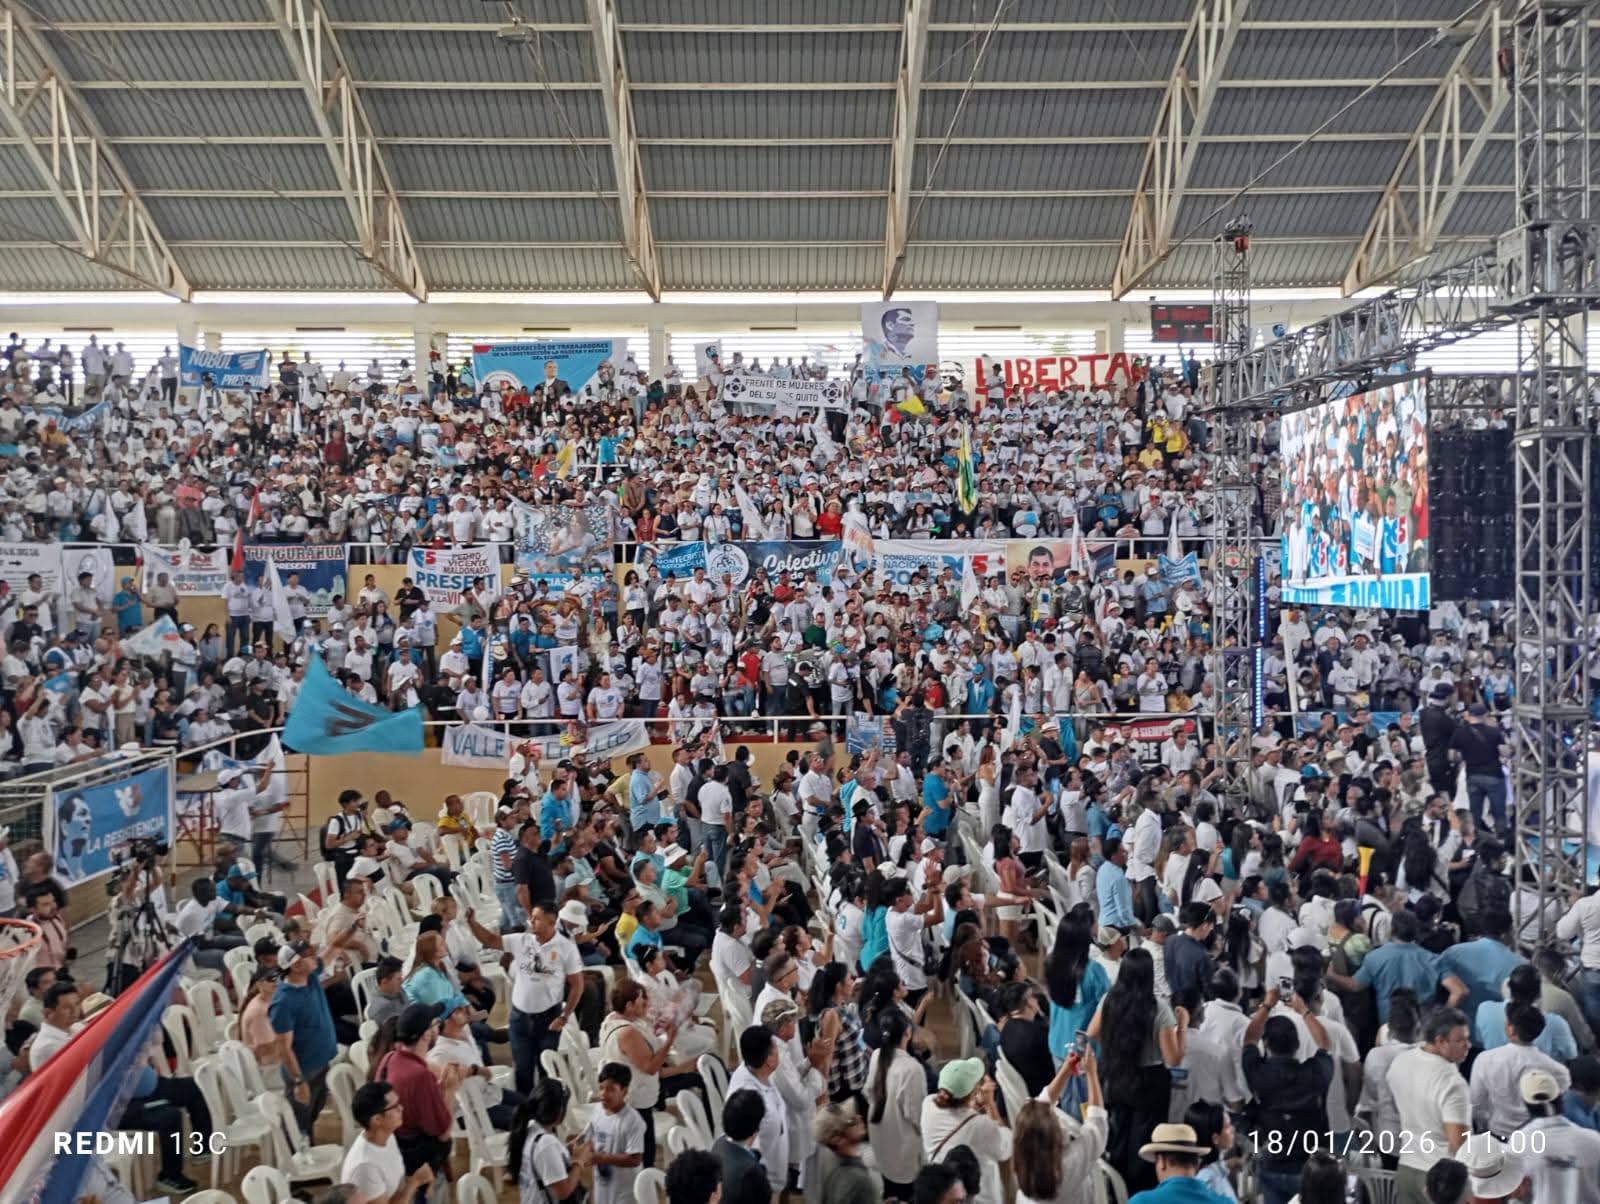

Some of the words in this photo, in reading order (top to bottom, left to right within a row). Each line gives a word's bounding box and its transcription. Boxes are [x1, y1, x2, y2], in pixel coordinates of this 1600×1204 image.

[557, 342, 609, 350] TRABAJADORES
[975, 352, 1150, 391] LIBERTA
[745, 379, 775, 390] FRENTE
[776, 381, 786, 390] DE
[788, 381, 825, 391] MUJERES
[749, 390, 762, 399] DEL
[765, 391, 778, 400] SU
[795, 392, 819, 402] QUITO
[242, 545, 345, 561] TUNGURAHUA
[425, 551, 437, 565] 5
[443, 566, 490, 574] MALDONADO
[762, 549, 840, 577] Colectivo
[415, 570, 497, 590] PRESET
[451, 731, 505, 759] VALLE
[86, 836, 101, 855] LA
